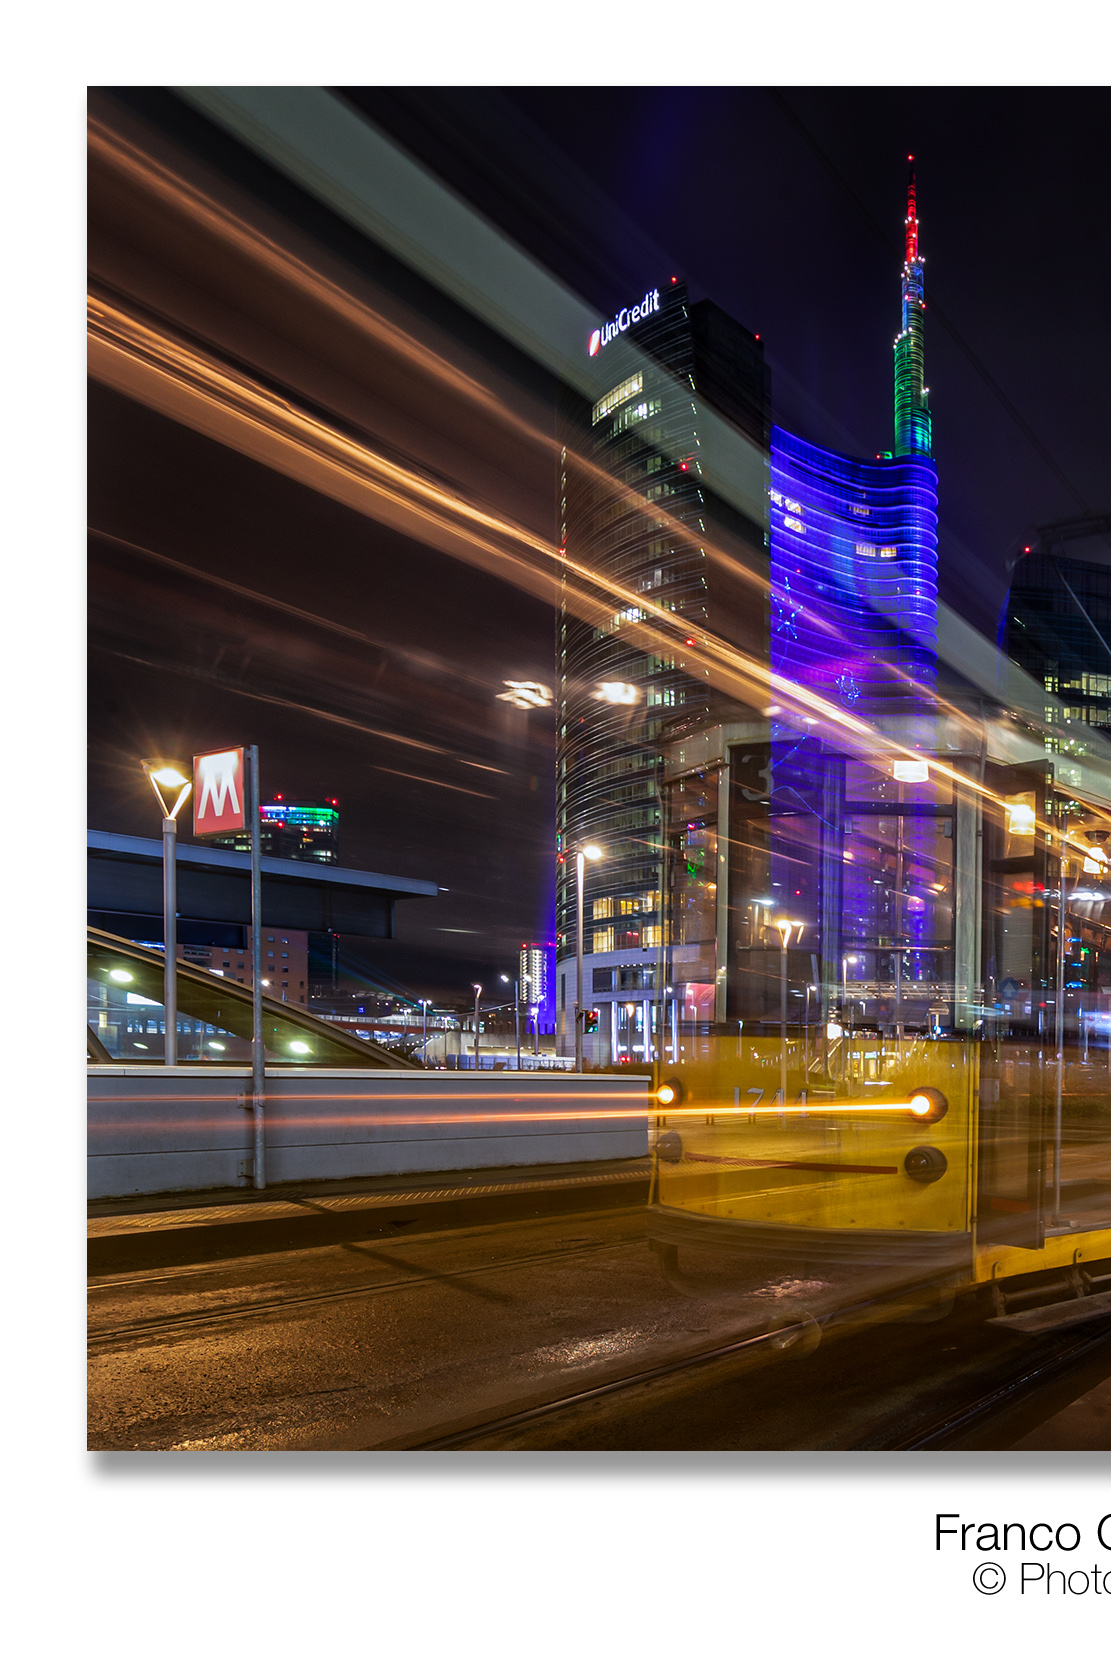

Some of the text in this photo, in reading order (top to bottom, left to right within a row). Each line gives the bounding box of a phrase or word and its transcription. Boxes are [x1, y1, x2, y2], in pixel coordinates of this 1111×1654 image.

[601, 288, 660, 346] UniCredit
[198, 751, 241, 819] M
[741, 755, 775, 801] 3
